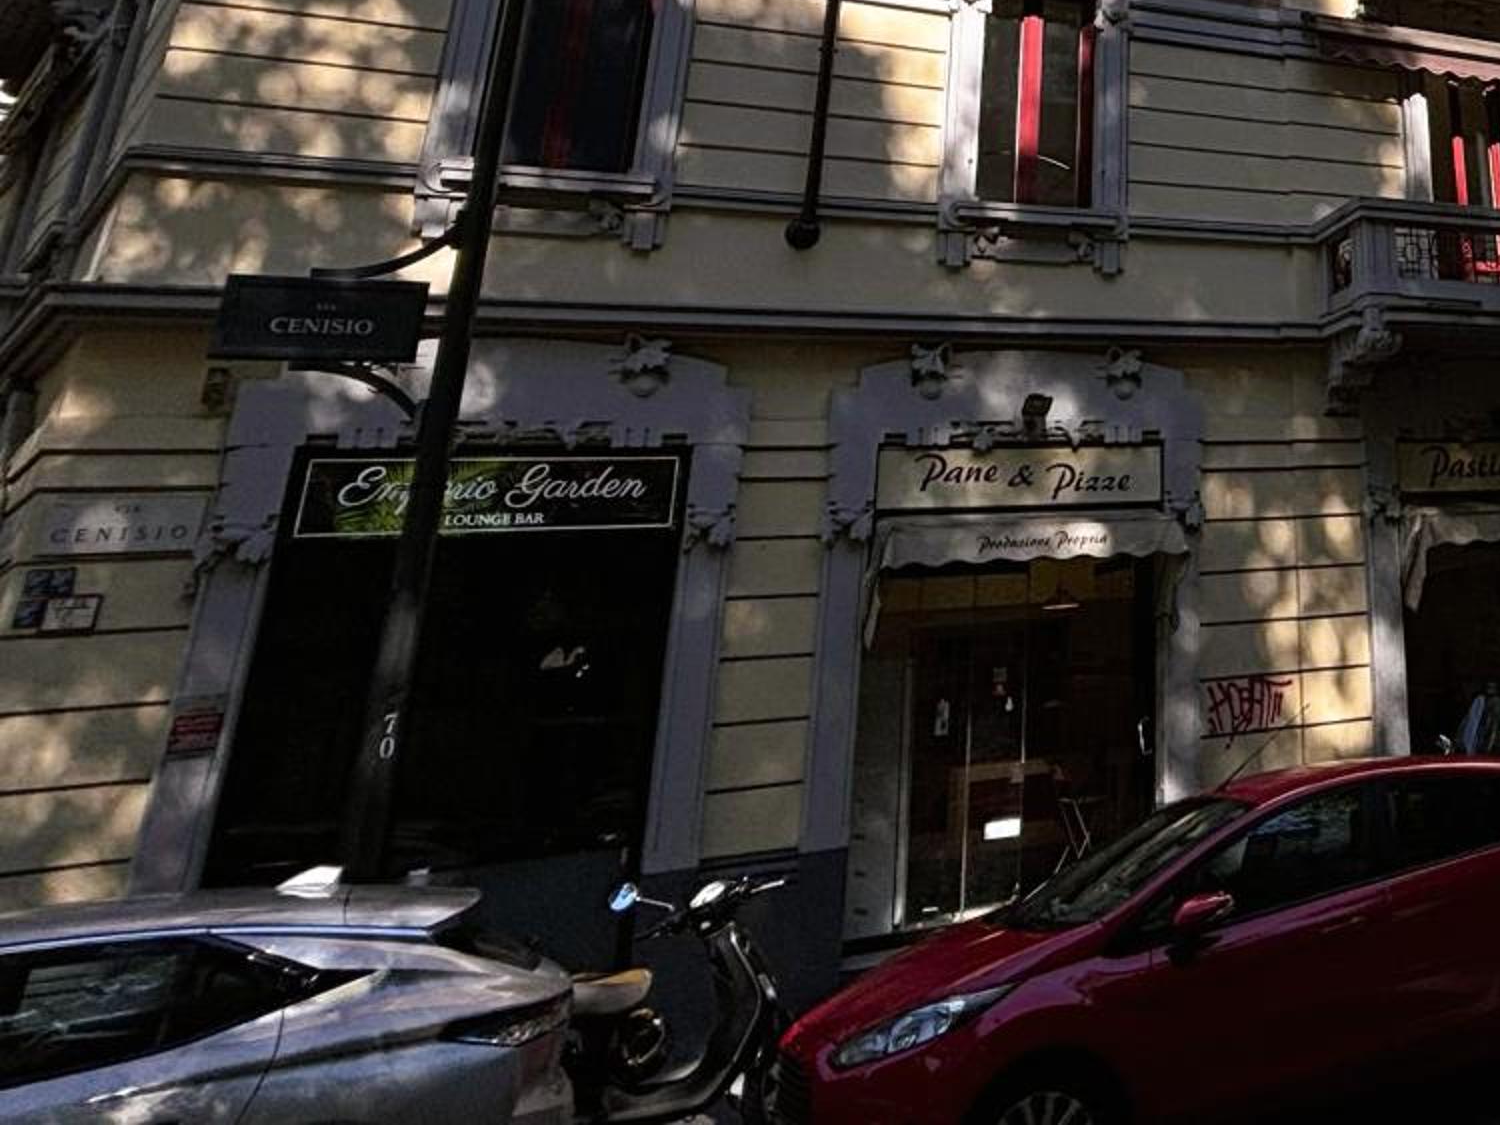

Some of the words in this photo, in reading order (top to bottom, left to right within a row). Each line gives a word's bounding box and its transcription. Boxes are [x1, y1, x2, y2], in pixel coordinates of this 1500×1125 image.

[268, 315, 375, 337] CENISIO
[914, 453, 999, 492] Pane
[1007, 464, 1035, 488] &
[1045, 462, 1131, 500] Pizze
[336, 465, 500, 515] Emrio
[503, 462, 646, 509] Garden
[443, 512, 512, 527] LOUNGE
[514, 511, 545, 525] BAR
[50, 525, 188, 544] CENISIO
